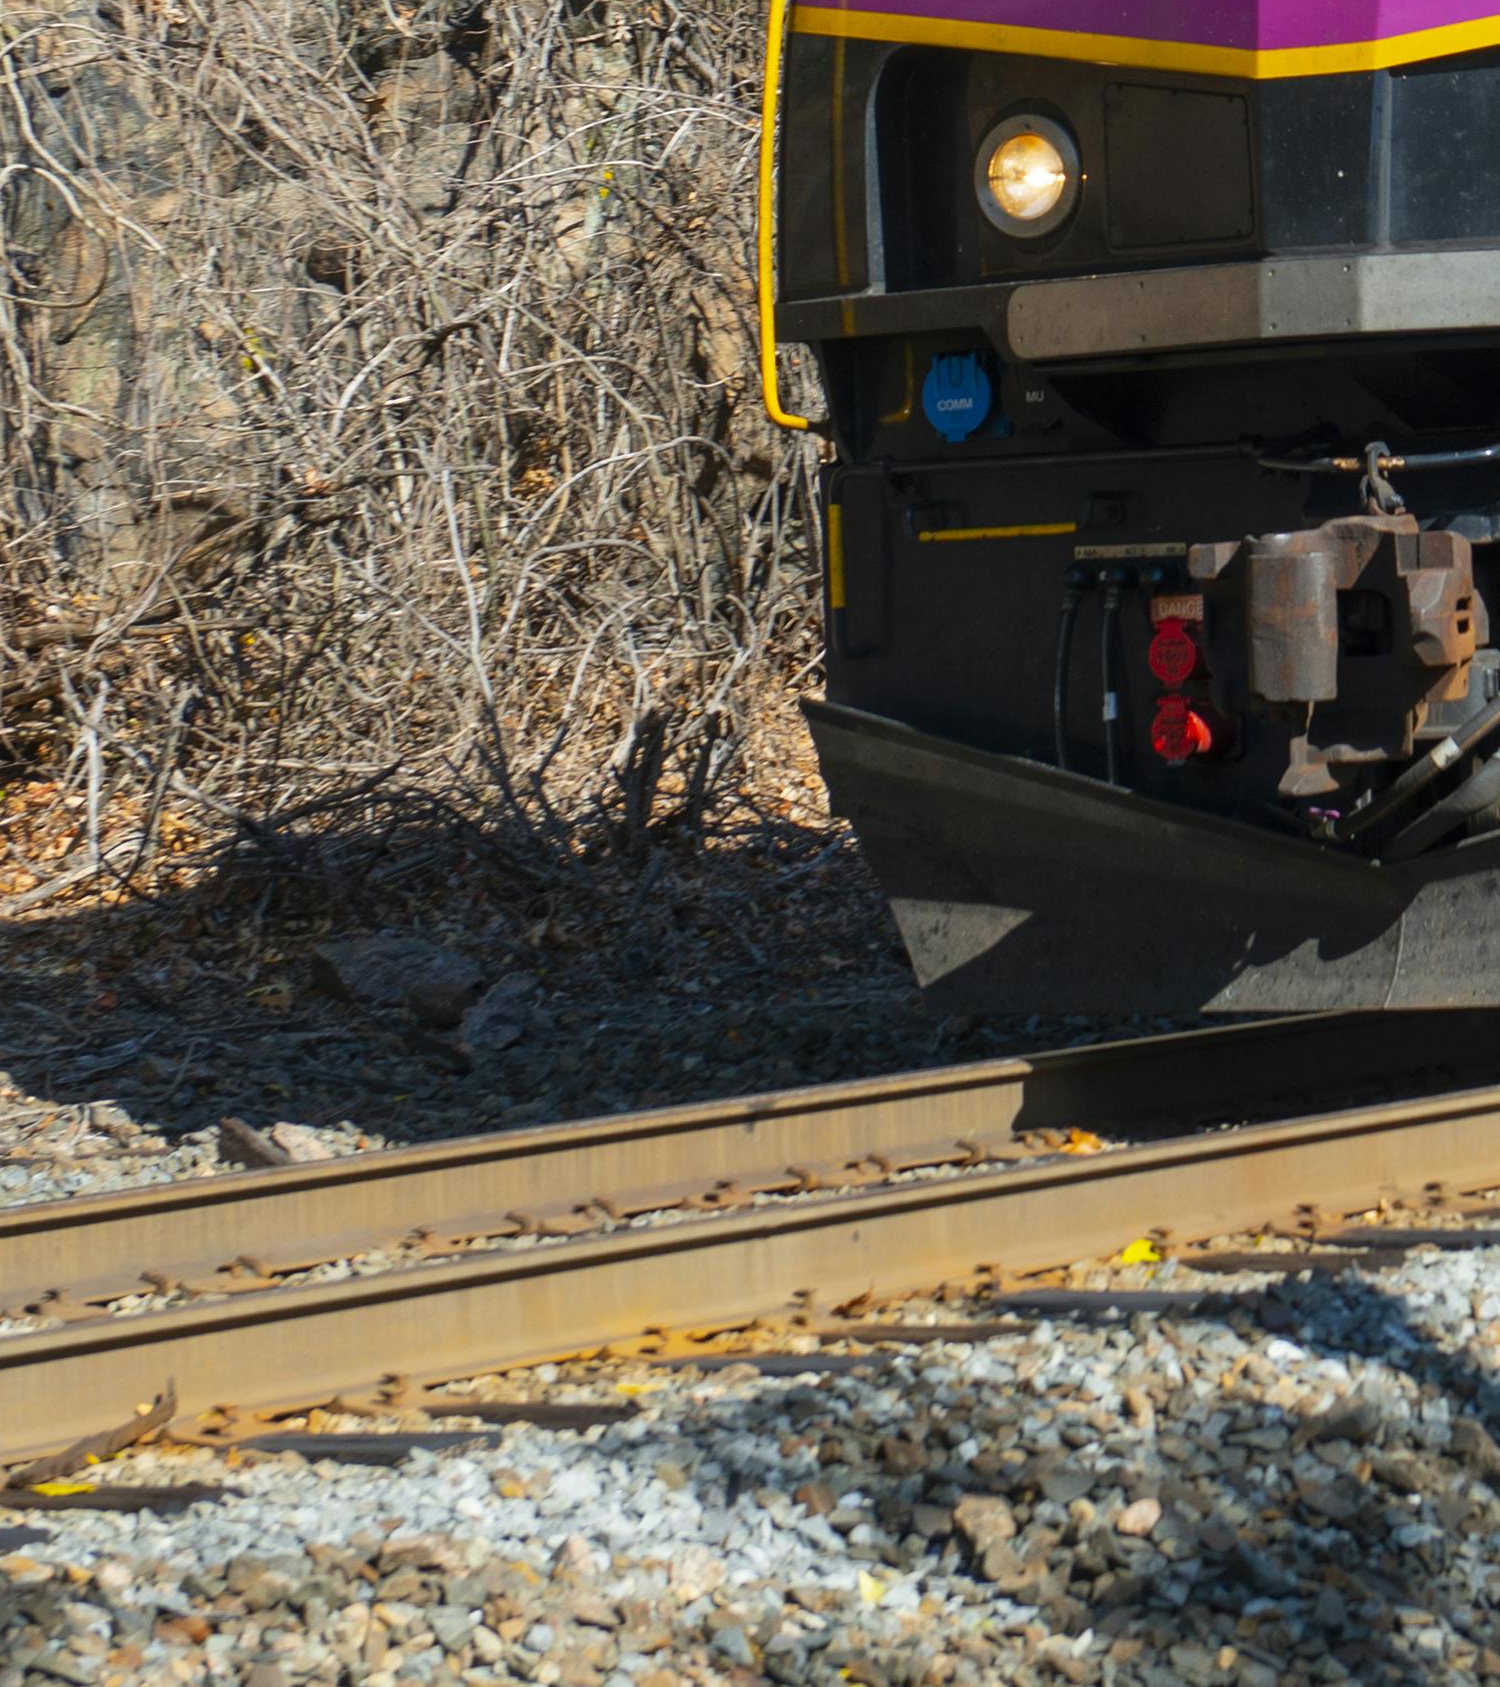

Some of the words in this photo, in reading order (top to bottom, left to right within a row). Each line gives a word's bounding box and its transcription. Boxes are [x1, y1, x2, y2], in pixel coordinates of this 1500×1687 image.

[1025, 390, 1045, 403] MU
[936, 397, 974, 412] COMM
[1158, 599, 1204, 616] DANGE
